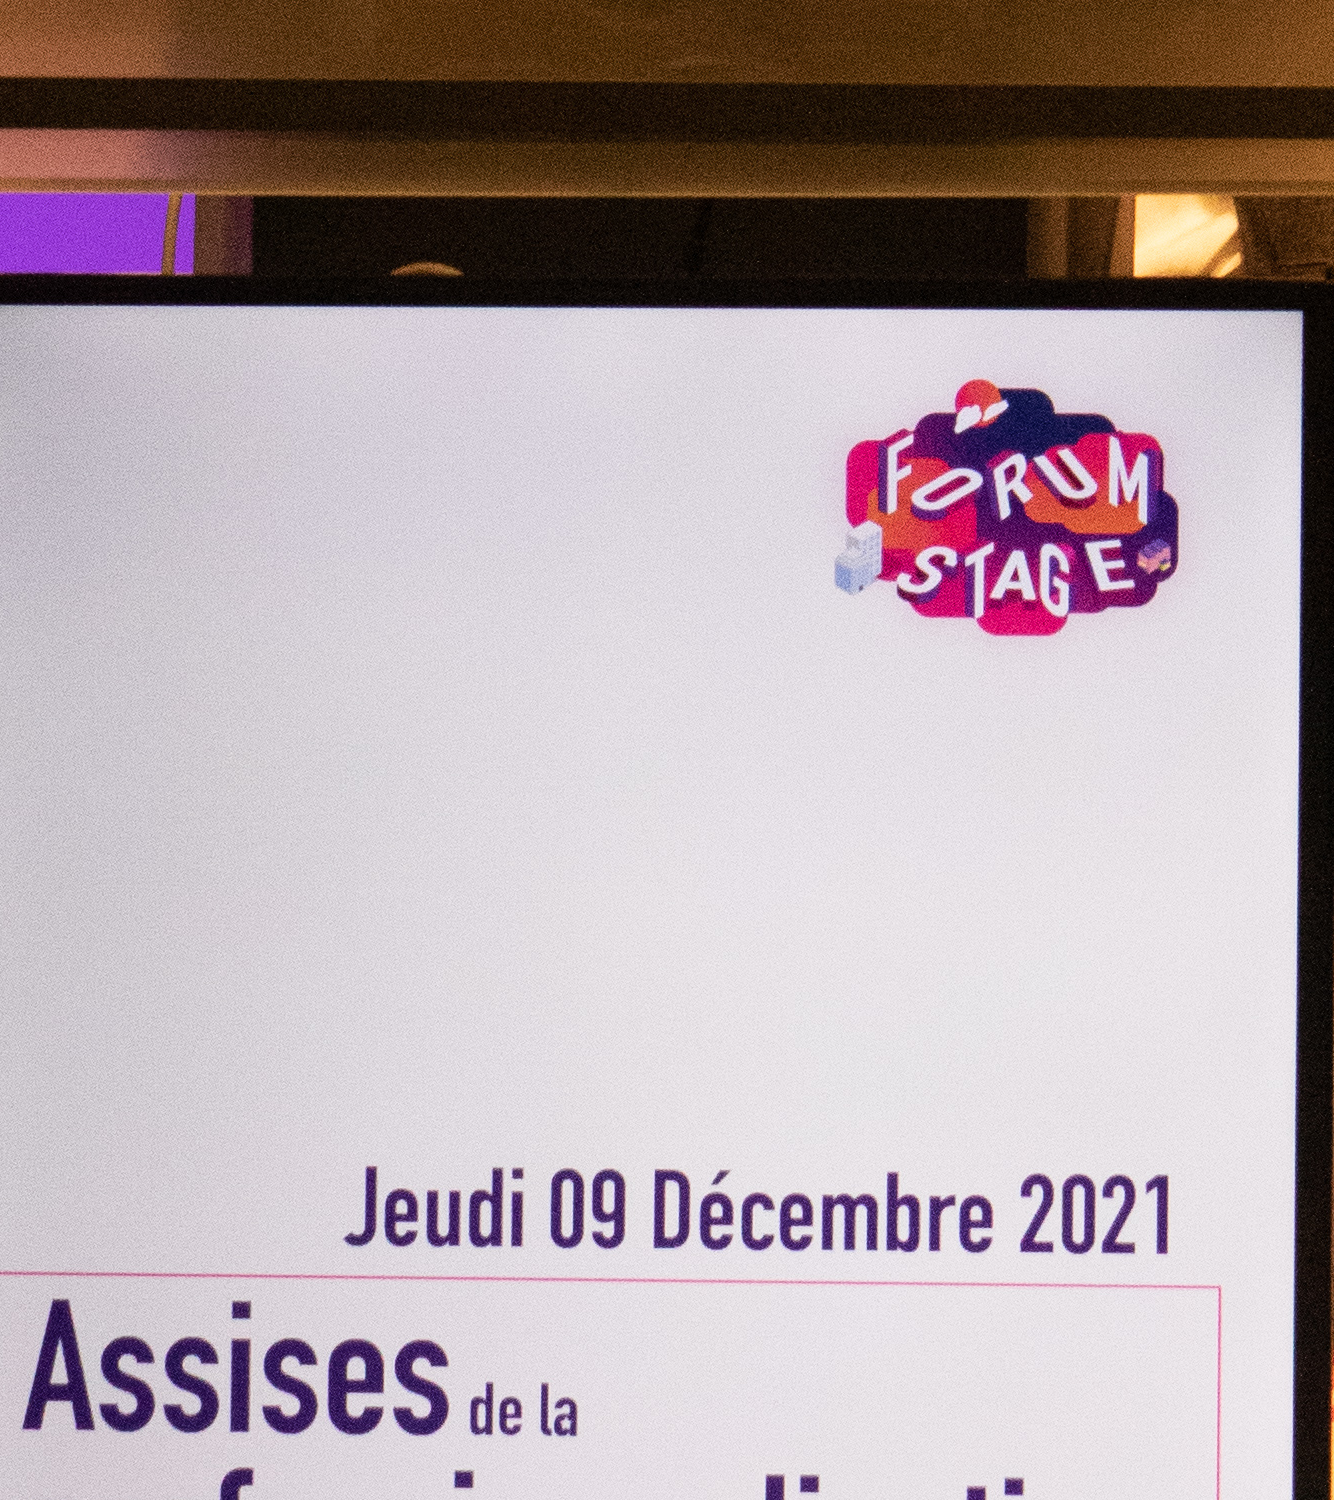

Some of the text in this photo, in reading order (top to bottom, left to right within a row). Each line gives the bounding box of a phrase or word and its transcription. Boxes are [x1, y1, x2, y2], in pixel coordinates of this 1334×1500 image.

[886, 433, 1149, 525] FORUM
[897, 539, 1135, 619] STAGE
[344, 1166, 1169, 1255] Jeudi 09 Décembre 2021
[22, 1299, 578, 1436] Assises de la
